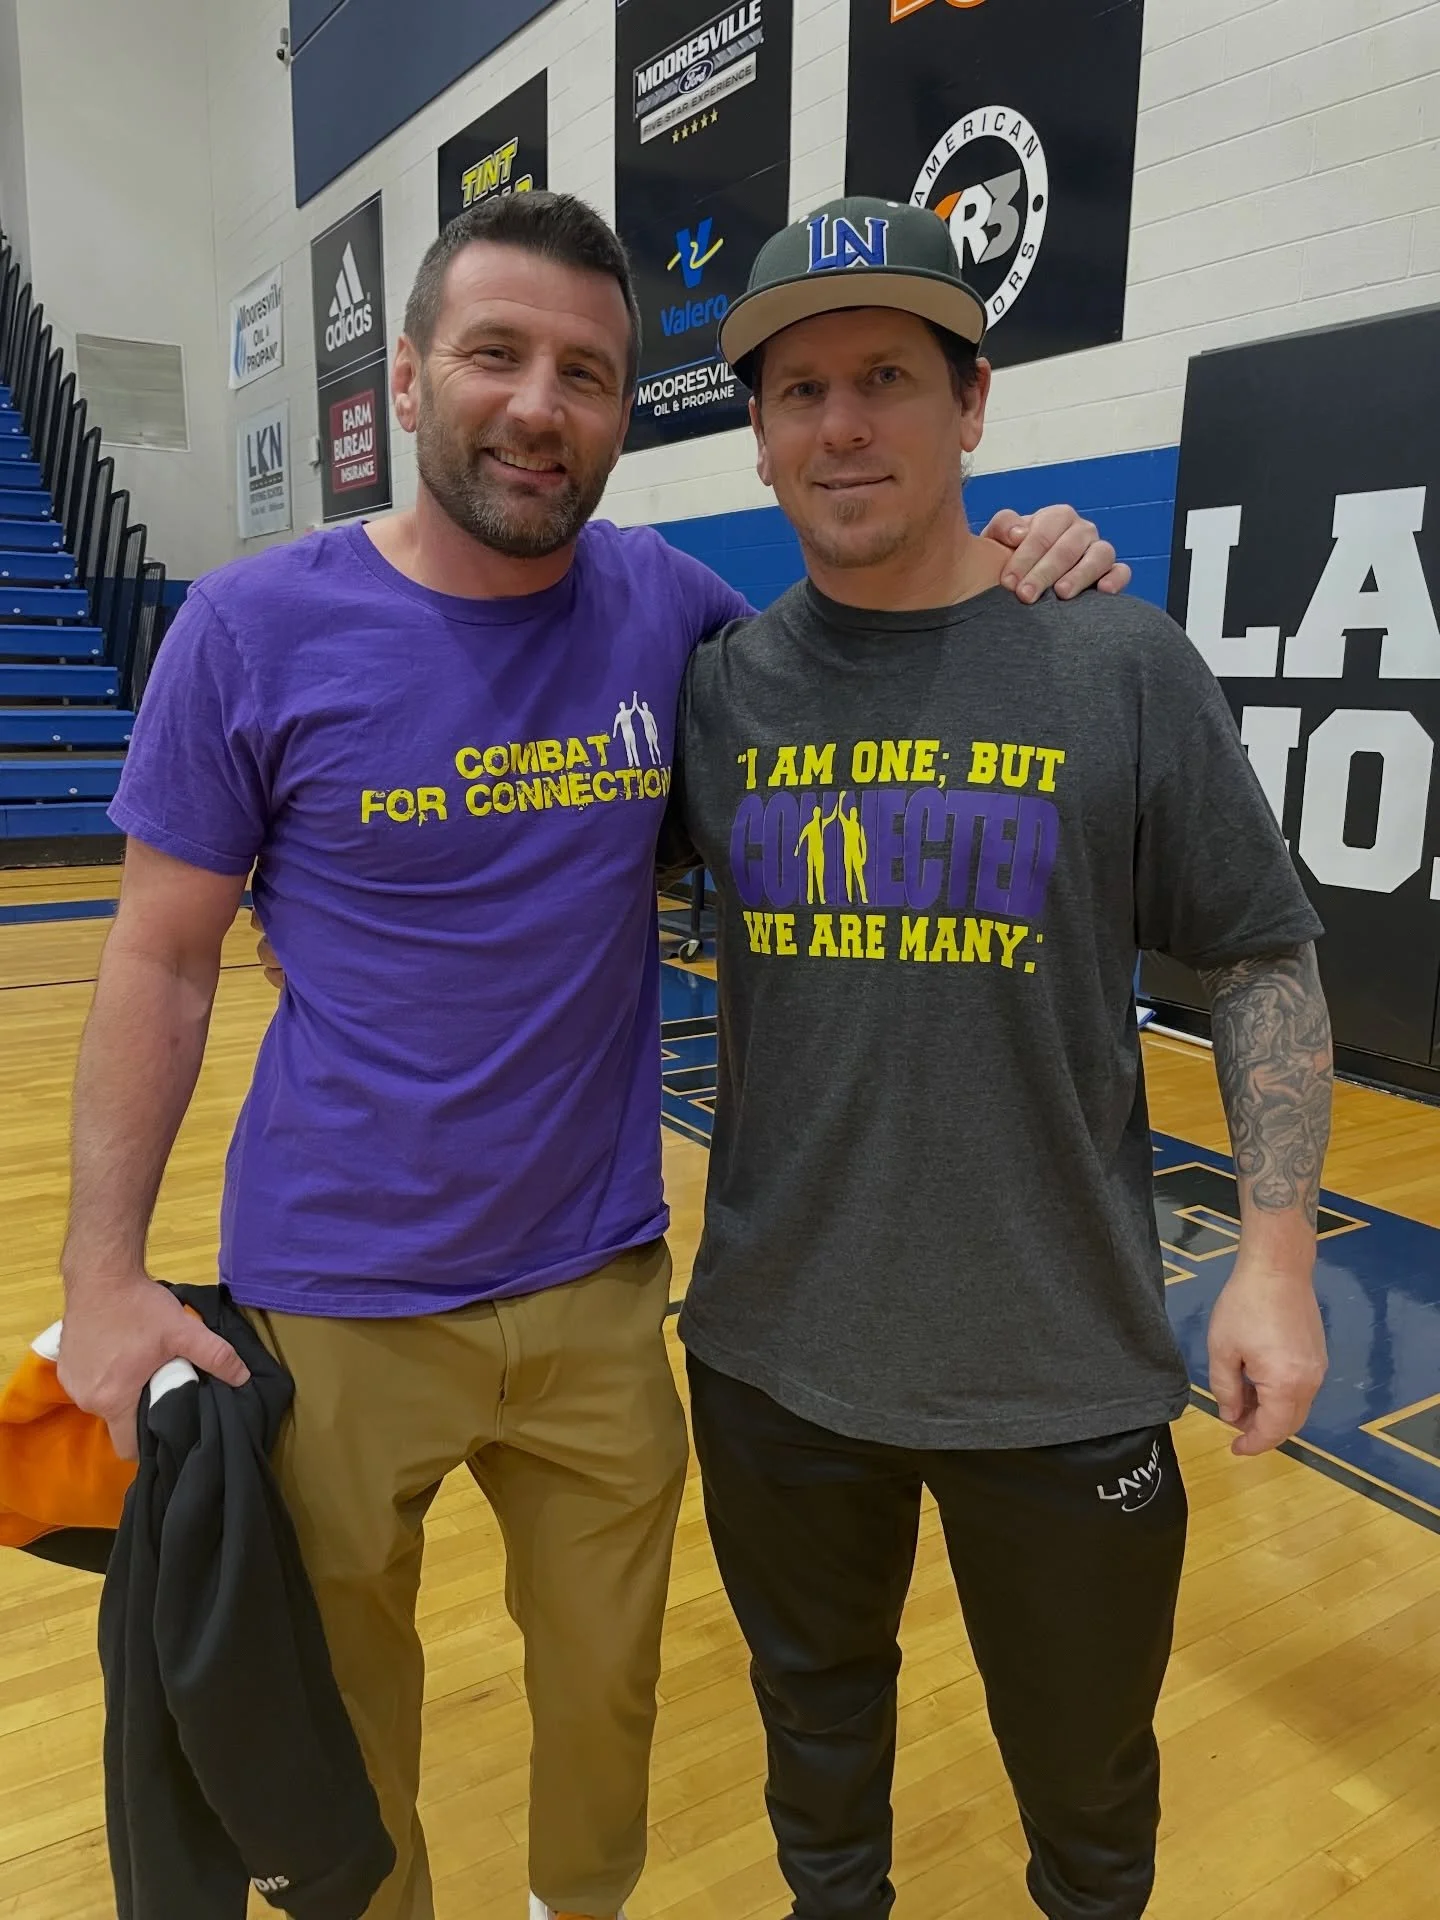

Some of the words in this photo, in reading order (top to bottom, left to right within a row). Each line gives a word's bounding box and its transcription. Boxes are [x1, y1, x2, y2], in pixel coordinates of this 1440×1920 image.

[637, 0, 762, 96] MOORESVILLE
[665, 100, 688, 122] STAR
[691, 65, 753, 107] EXPERIENCE
[683, 66, 708, 91] Ford
[461, 137, 518, 208] TINT
[913, 112, 1039, 209] AMERICAN
[806, 213, 889, 273] LN
[325, 302, 373, 352] adidas
[661, 294, 730, 337] Valero
[342, 402, 372, 433] FARM
[653, 403, 671, 417] OIL
[672, 399, 680, 411] &
[681, 385, 735, 410] PROPANE
[247, 421, 283, 478] LKN
[333, 428, 373, 462] BUREAU
[455, 733, 611, 780] COMBAT
[768, 743, 837, 787] AM
[851, 740, 950, 789] ONE;
[967, 741, 1066, 793] BUT
[361, 786, 448, 826] FOR
[465, 765, 672, 817] CONNECTION
[730, 787, 1060, 918] CONNECTED
[742, 911, 798, 956] WE
[808, 913, 886, 960] ARE
